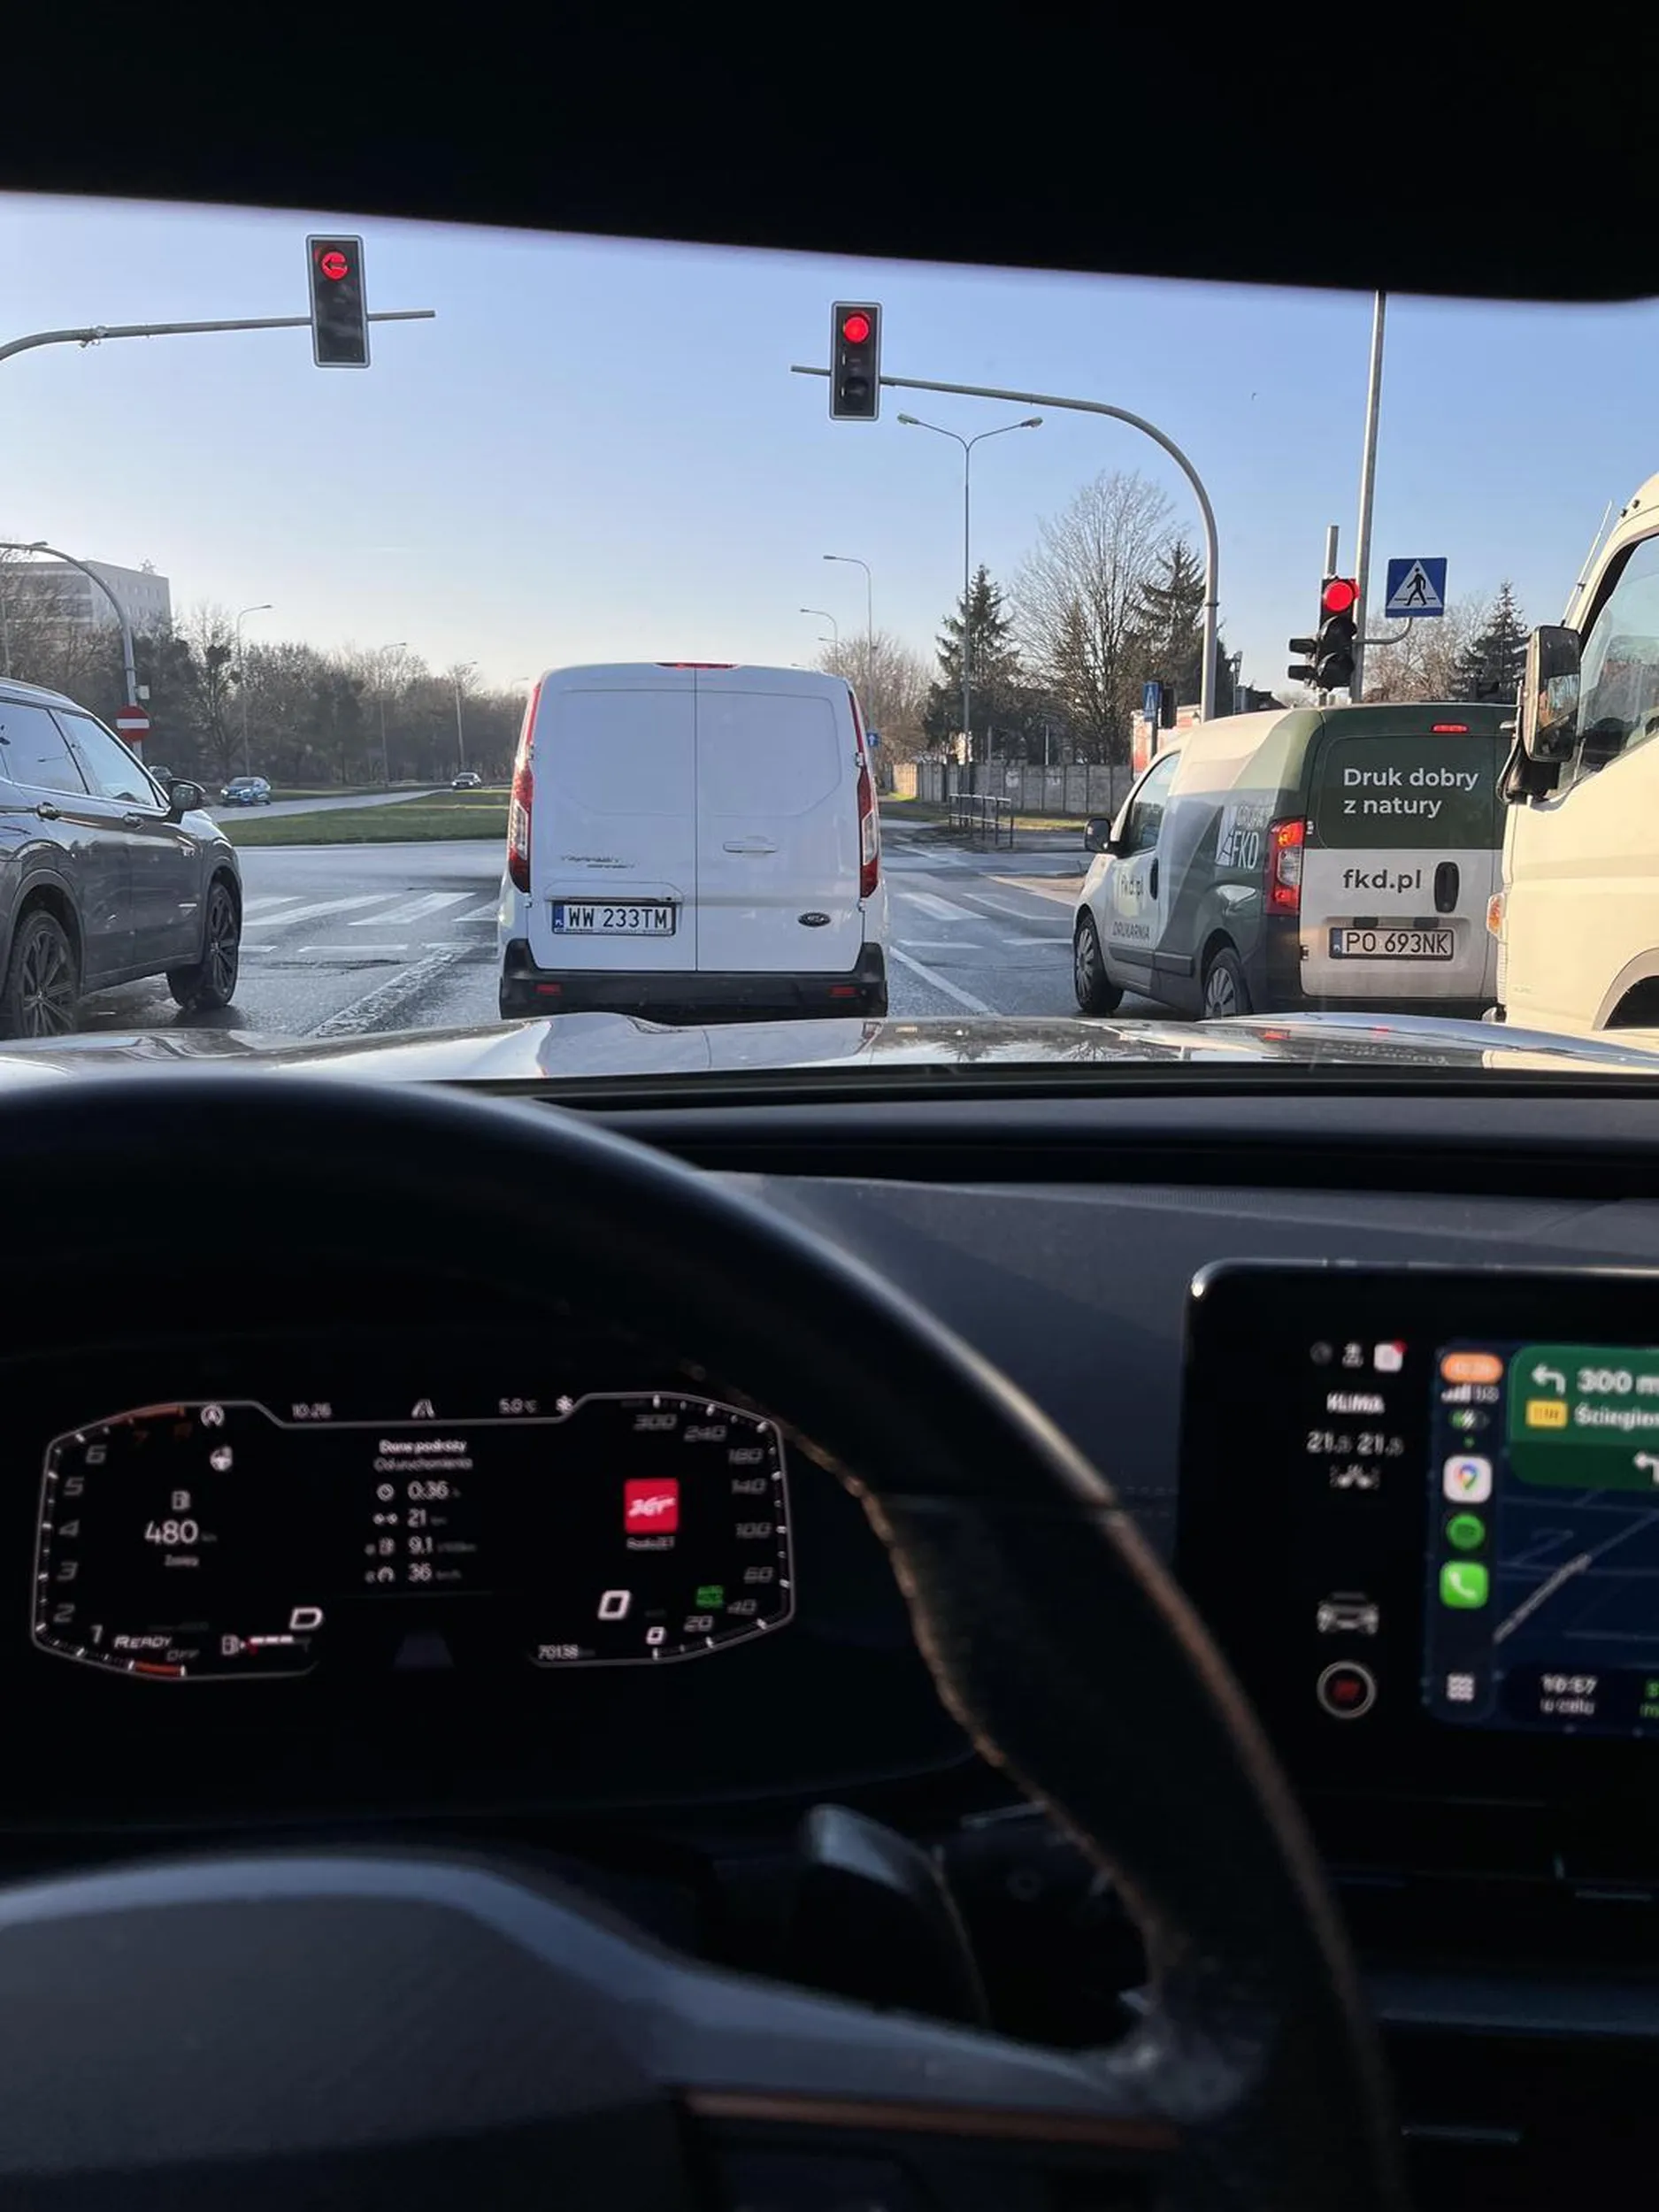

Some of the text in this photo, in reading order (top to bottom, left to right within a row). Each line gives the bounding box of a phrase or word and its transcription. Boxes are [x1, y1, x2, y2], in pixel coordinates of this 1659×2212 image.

[1343, 767, 1479, 791] Druk dobry
[1343, 797, 1442, 818] z natury
[1342, 869, 1421, 894] fkd.pl
[568, 908, 667, 928] WW 233TM
[1346, 933, 1448, 954] PO 693NK
[1577, 1368, 1632, 1394] 300
[86, 1444, 107, 1463] 6
[64, 1477, 84, 1496] 5
[58, 1519, 80, 1538] 4
[143, 1519, 199, 1545] 480
[57, 1561, 79, 1582] 3
[53, 1603, 75, 1624] 2
[597, 1590, 631, 1620] 0
[289, 1607, 323, 1630] D
